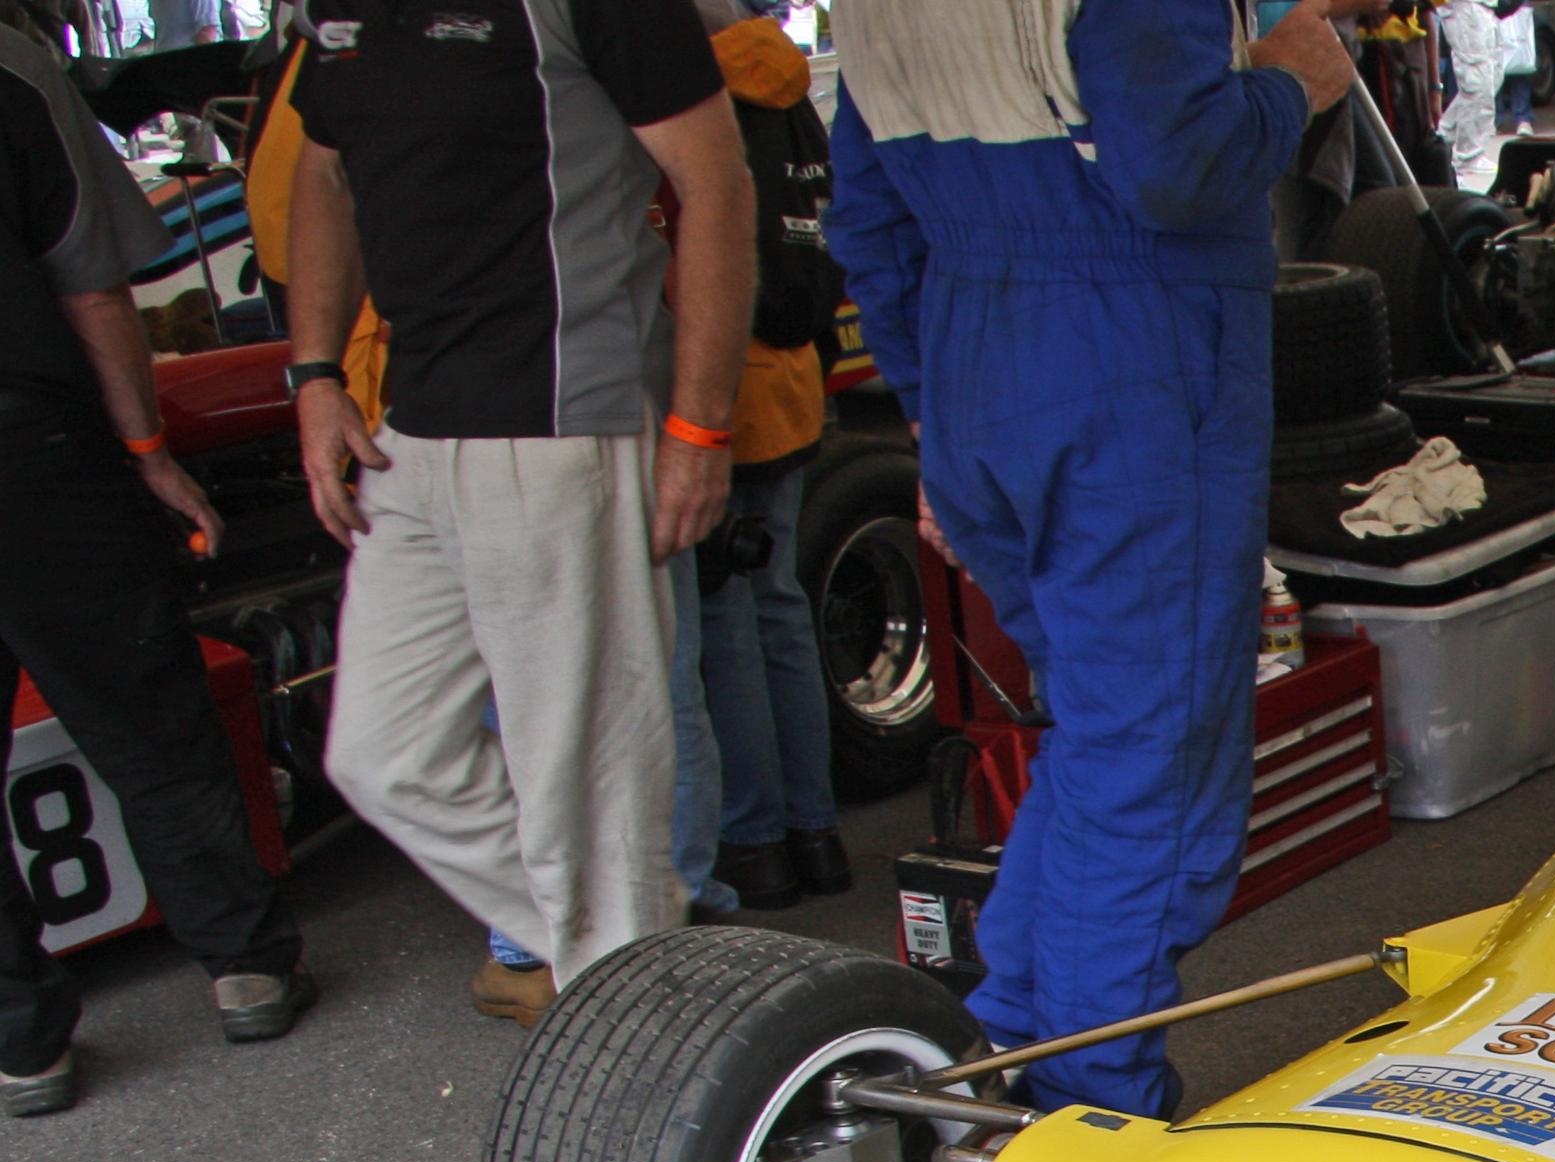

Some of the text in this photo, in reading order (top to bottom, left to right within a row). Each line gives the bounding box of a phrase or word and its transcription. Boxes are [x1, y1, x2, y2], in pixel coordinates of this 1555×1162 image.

[913, 928, 940, 940] HEAVY
[917, 939, 939, 950] DUTY
[1371, 1098, 1507, 1128] GROUP
